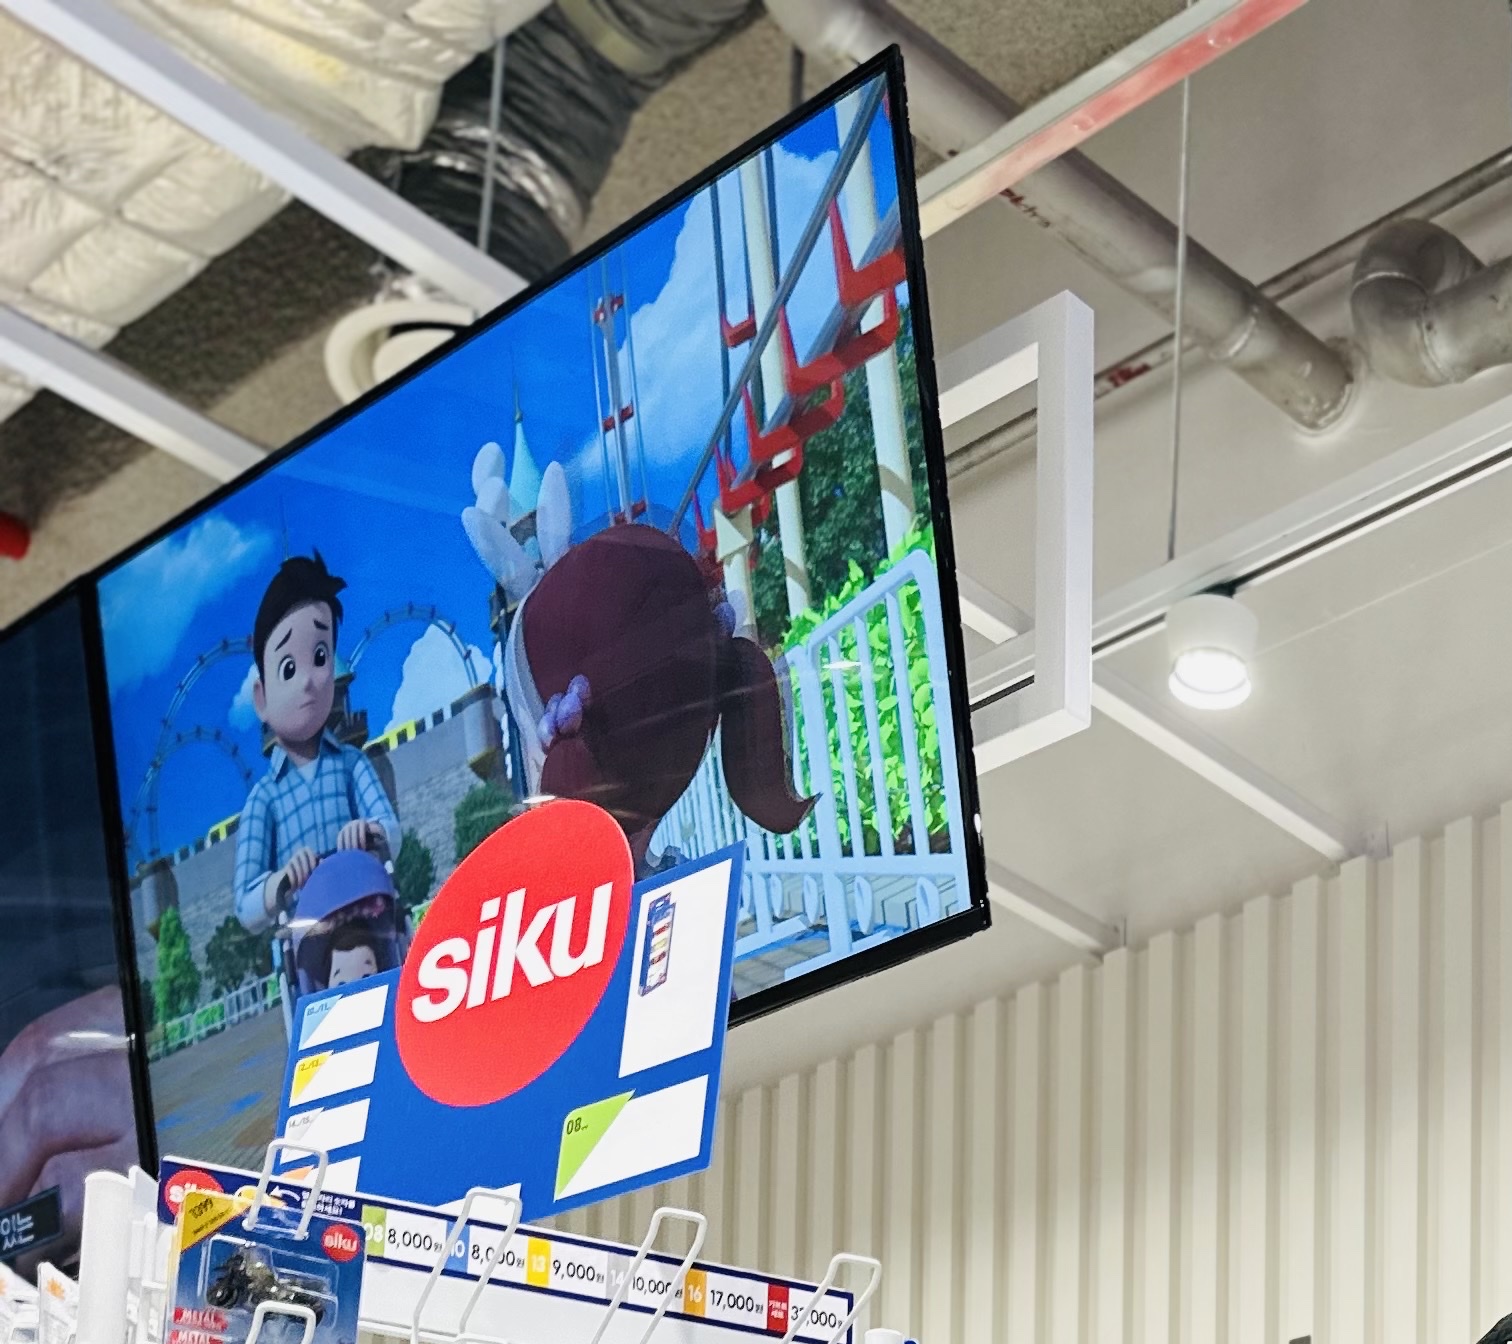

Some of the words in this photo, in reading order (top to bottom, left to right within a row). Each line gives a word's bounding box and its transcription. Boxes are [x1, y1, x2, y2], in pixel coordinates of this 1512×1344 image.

[411, 882, 612, 1023] siku
[530, 1253, 546, 1272] 13
[688, 1285, 703, 1303] 16
